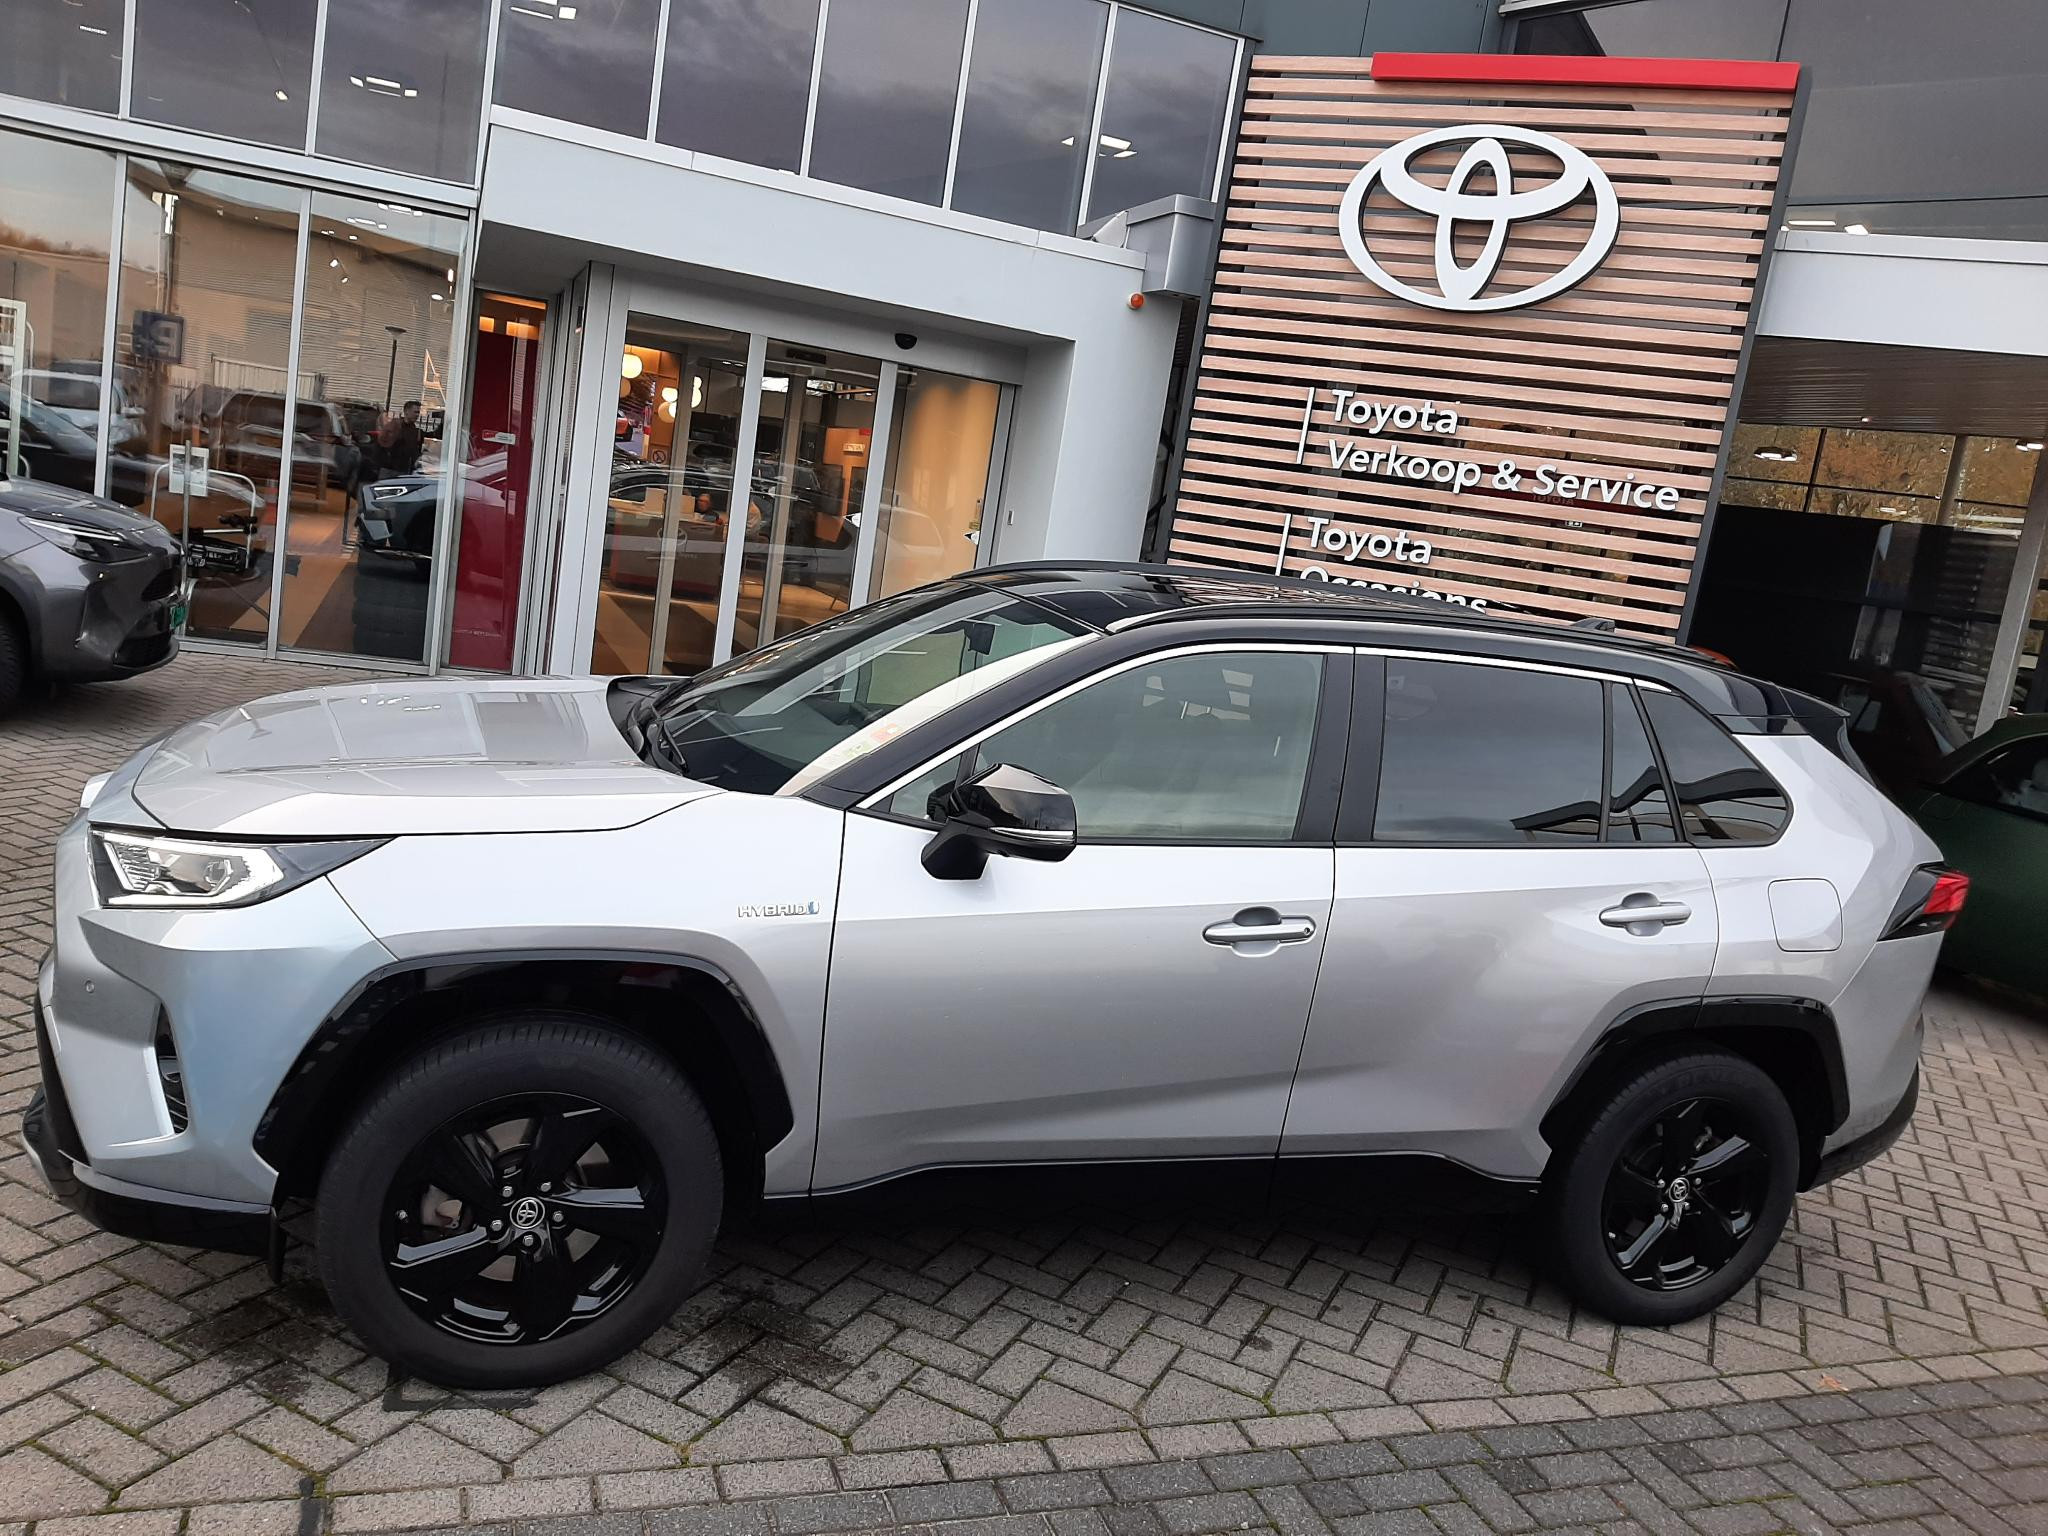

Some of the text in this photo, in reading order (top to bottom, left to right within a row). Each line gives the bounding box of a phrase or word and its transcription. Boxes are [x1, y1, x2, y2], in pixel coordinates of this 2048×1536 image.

[1332, 389, 1458, 434] Toyota
[1328, 439, 1680, 511] Verkoop & Service
[1307, 517, 1432, 564] Toyota
[738, 904, 807, 918] HYBRID
